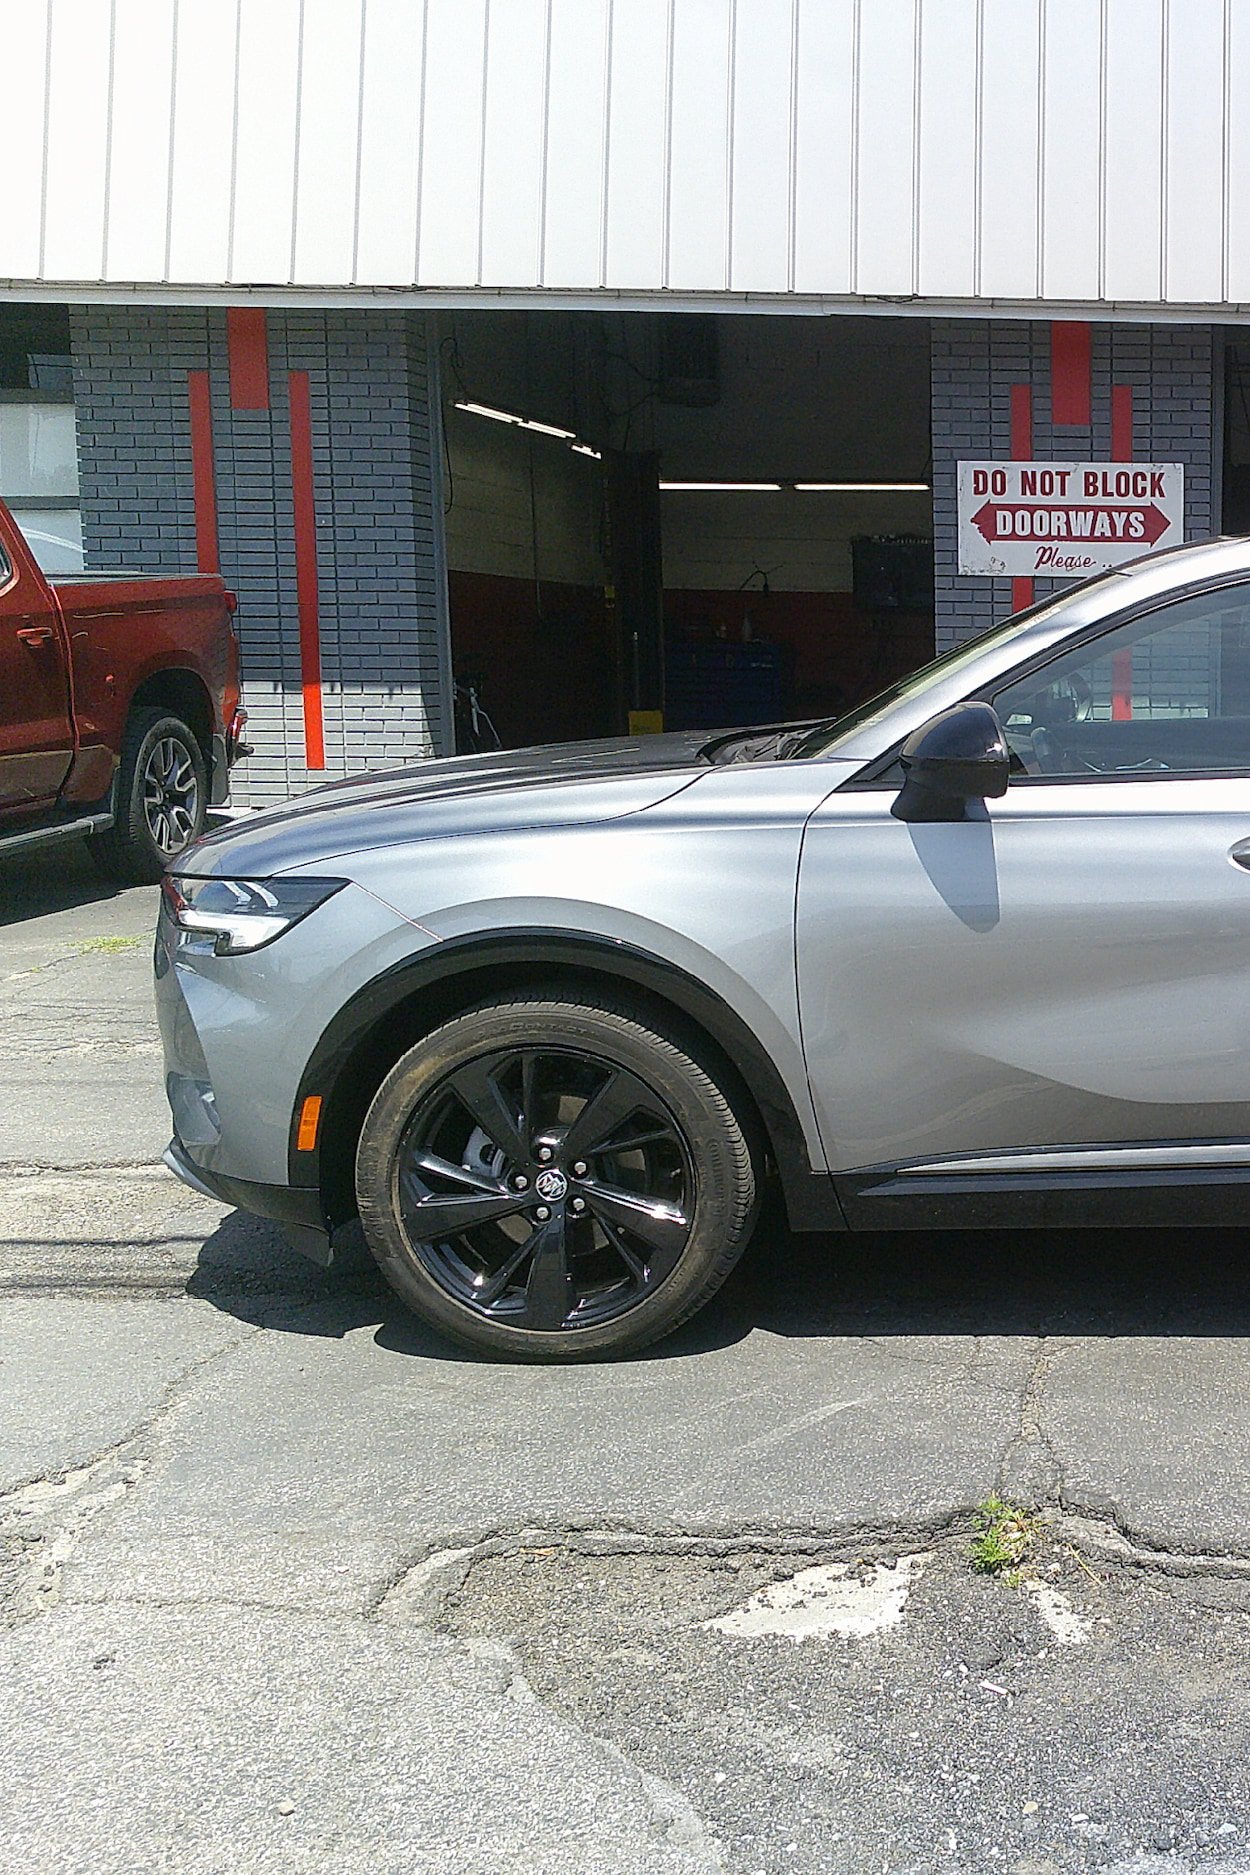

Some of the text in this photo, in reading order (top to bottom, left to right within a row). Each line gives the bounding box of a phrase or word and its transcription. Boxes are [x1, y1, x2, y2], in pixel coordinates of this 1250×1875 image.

[972, 469, 1166, 498] DO NOT BLOCK
[996, 510, 1145, 538] DOORWAYS
[1034, 546, 1097, 571] Please
